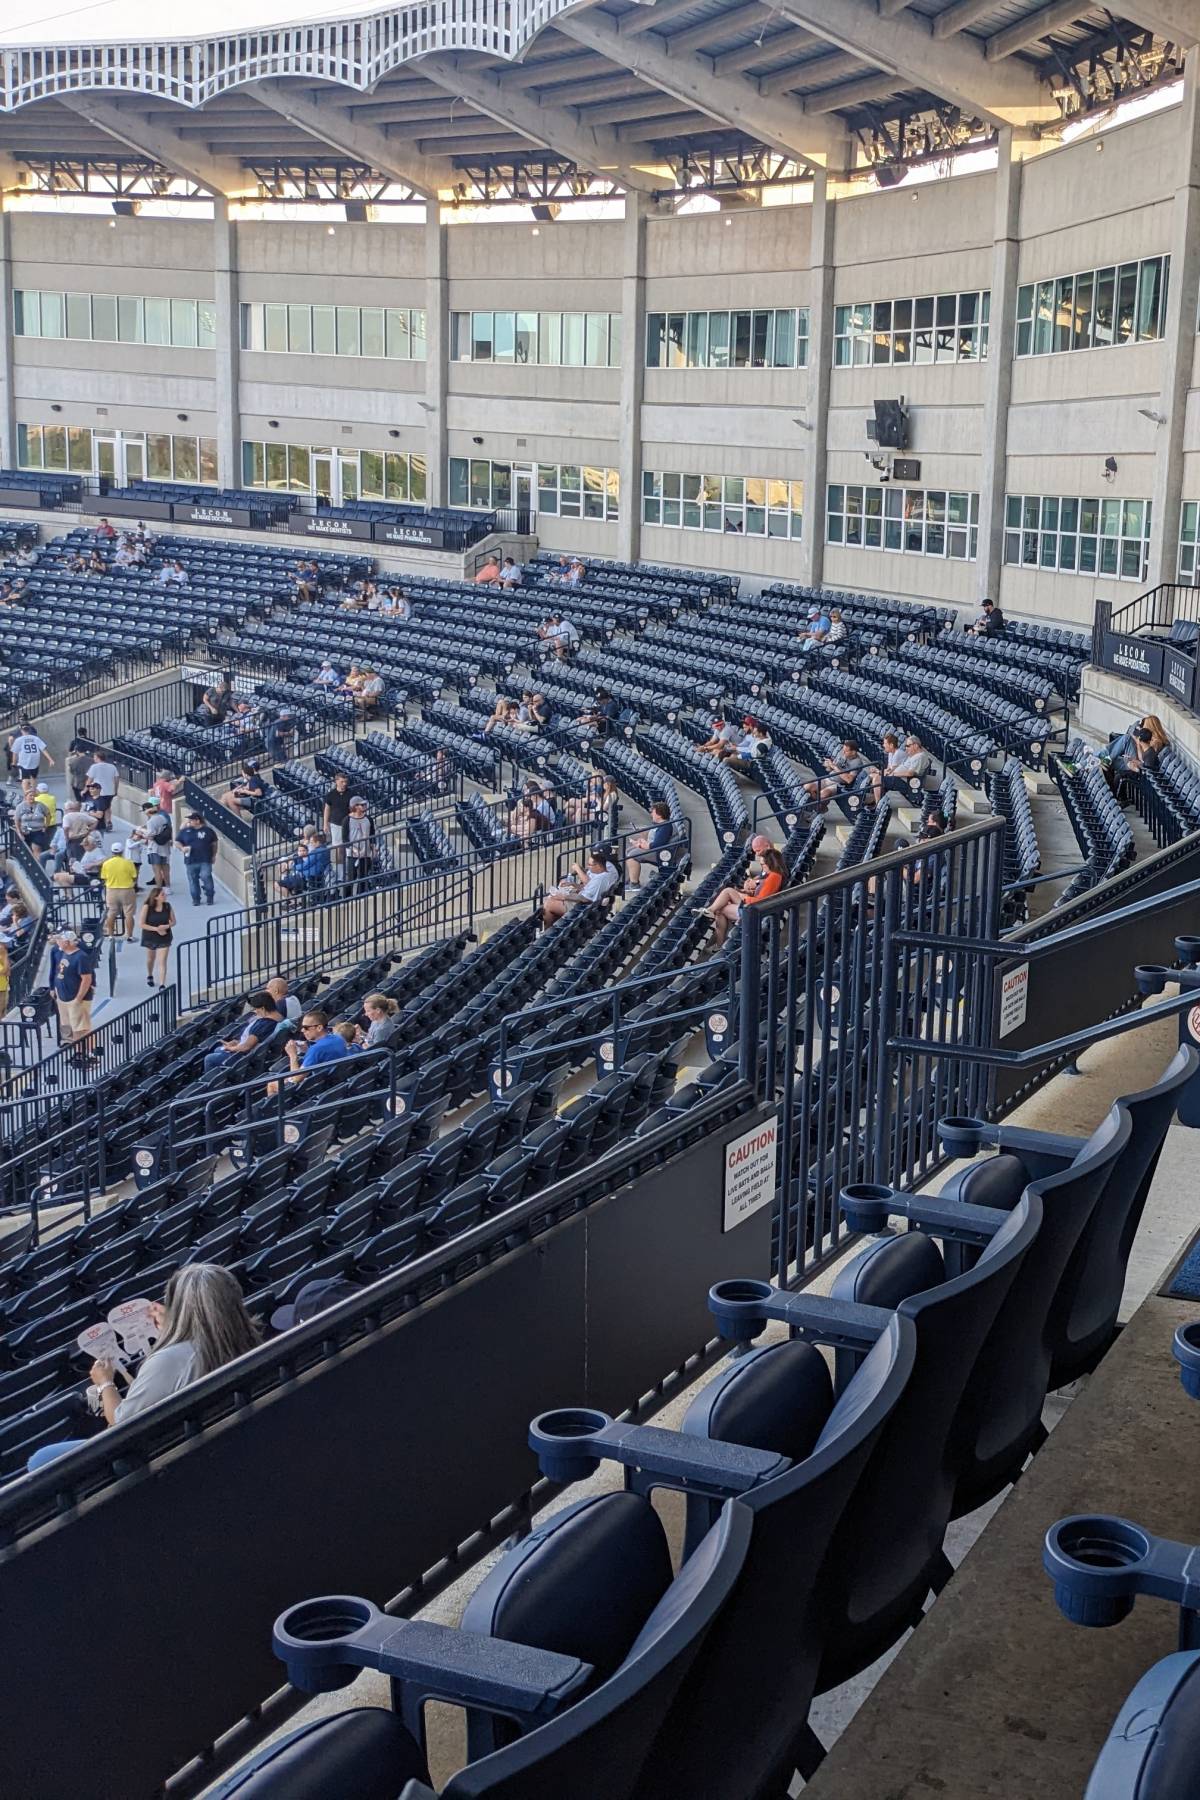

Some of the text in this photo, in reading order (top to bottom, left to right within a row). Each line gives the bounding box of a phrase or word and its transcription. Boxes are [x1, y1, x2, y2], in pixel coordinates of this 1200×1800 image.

[312, 518, 348, 529] LECOM
[393, 527, 424, 538] LECOM
[1119, 643, 1145, 662] LECOM
[24, 743, 37, 753] 99
[1004, 970, 1027, 993] CAUTION
[729, 1128, 775, 1168] CAUTION
[733, 1153, 769, 1180] WATCH OUT FOR
[727, 1184, 738, 1196] LIVE
[751, 1170, 760, 1180] AND
[739, 1201, 748, 1211] ALL
